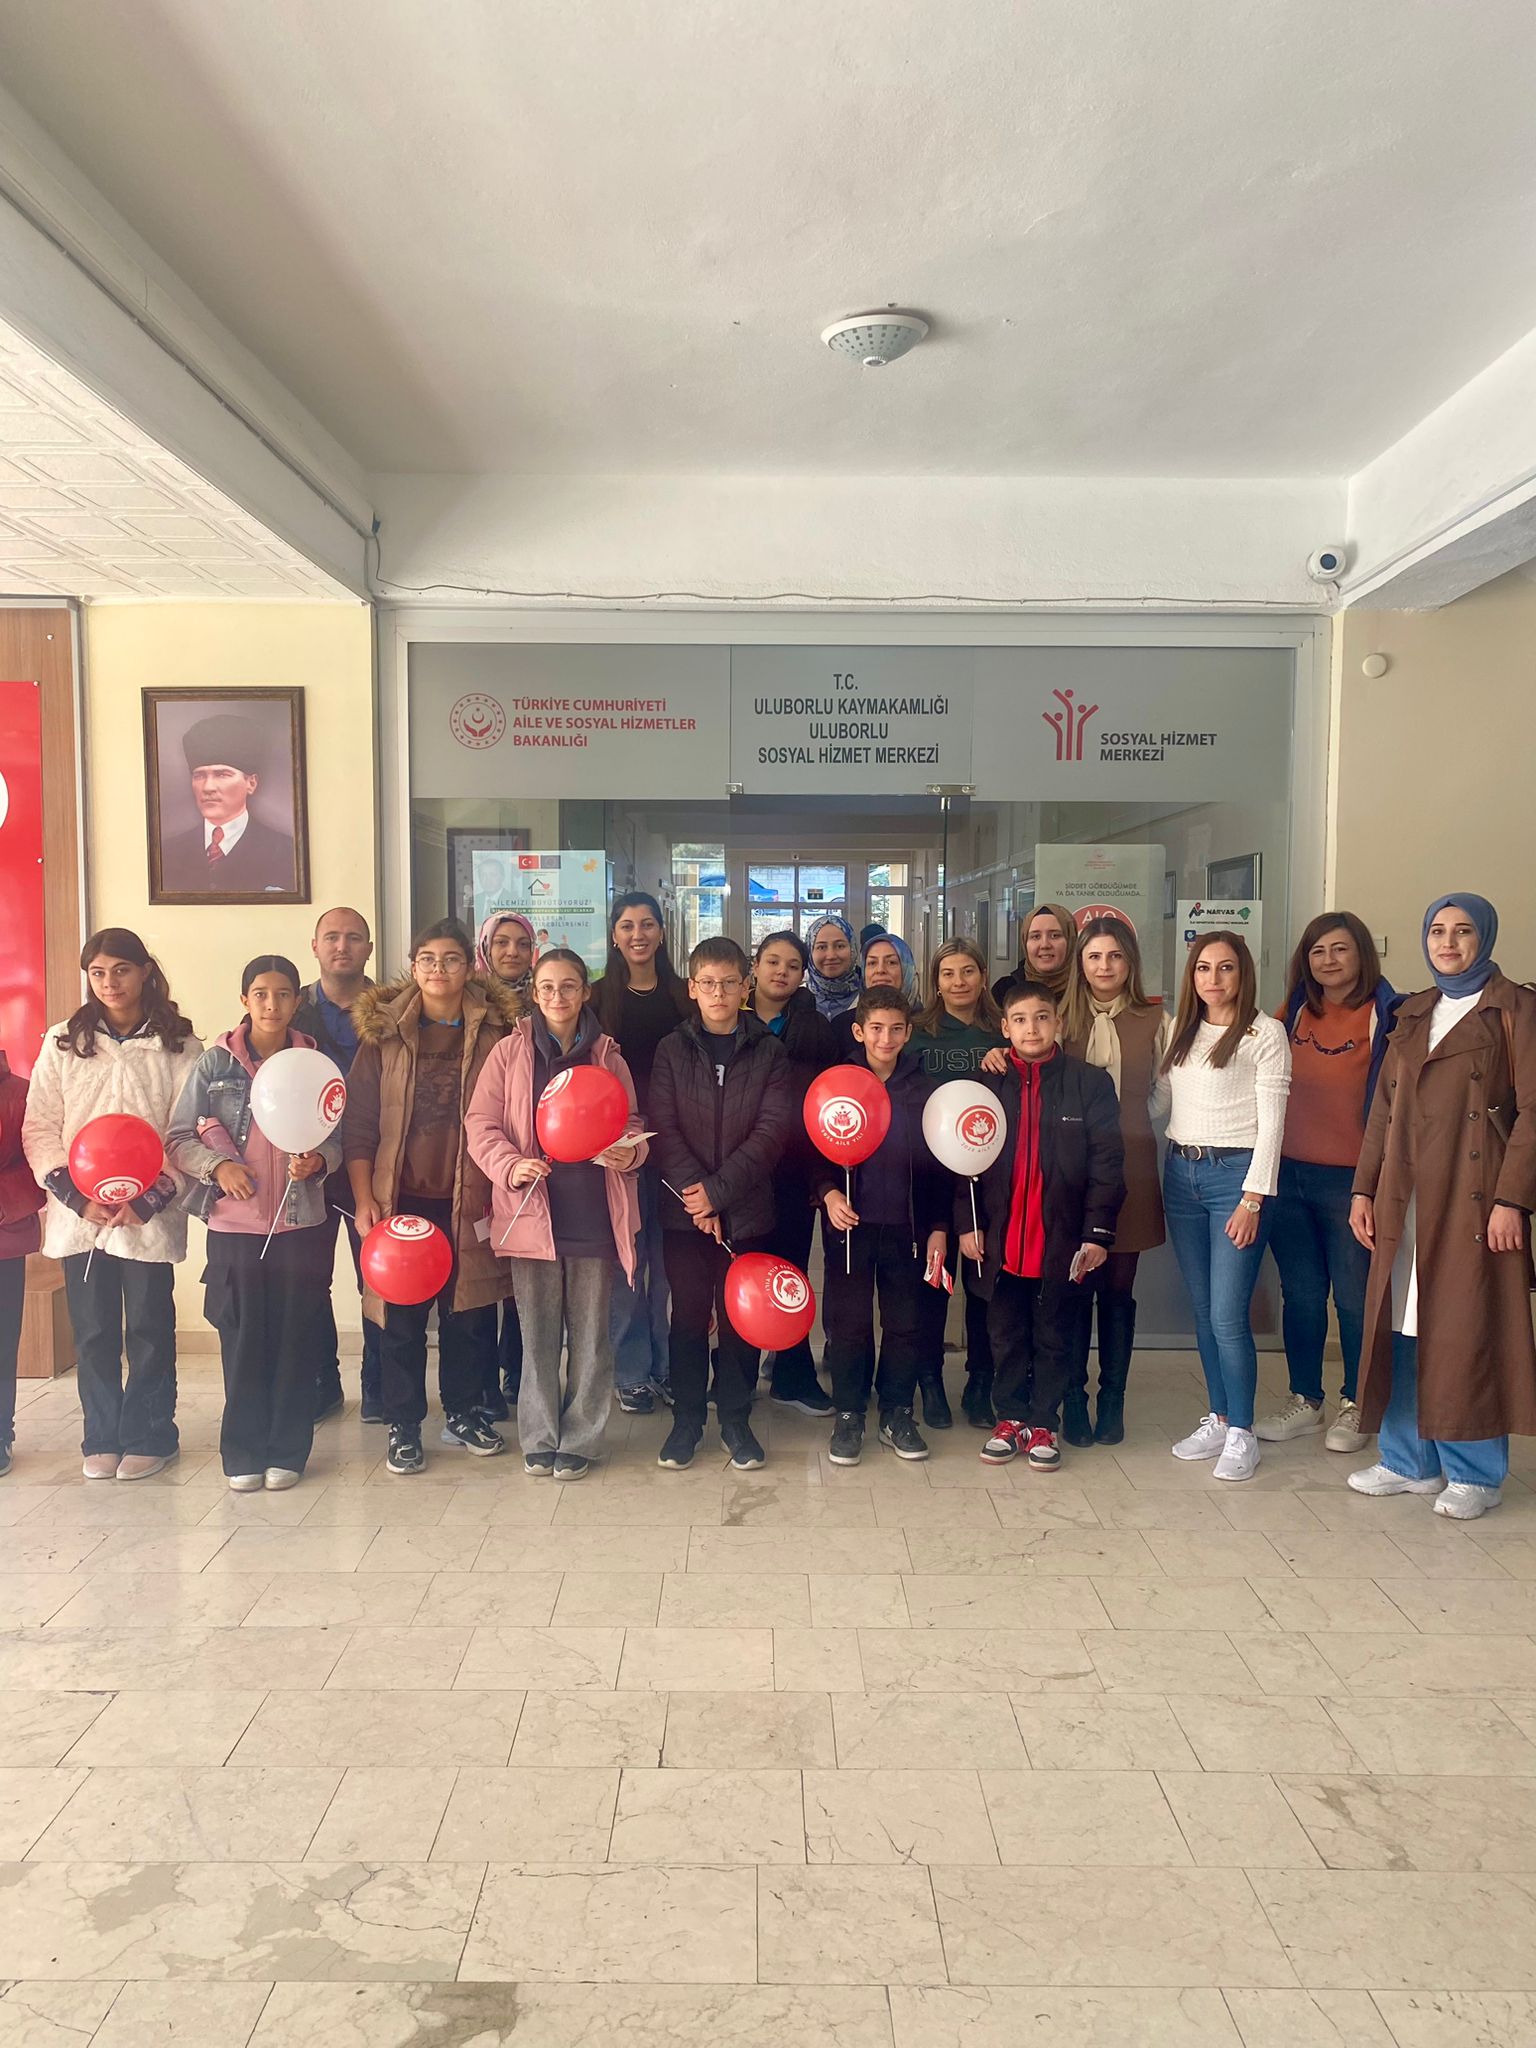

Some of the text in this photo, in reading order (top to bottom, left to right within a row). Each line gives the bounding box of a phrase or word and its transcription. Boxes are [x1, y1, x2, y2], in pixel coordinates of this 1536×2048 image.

[833, 673, 858, 690] T.C.
[512, 696, 666, 712] TÜRKİYE CUMHURİYETİ
[754, 694, 949, 715] ULUBORLU KAYMAKAMLIĞI
[513, 716, 696, 731] AİLE VE SOSYAL HİZMETLER
[809, 722, 888, 739] ULUBORLU
[513, 733, 588, 747] BAKANLIĞI
[1100, 731, 1217, 746] SOSYAL HİZMET
[758, 743, 939, 764] SOSYAL HİZMET MERKEZİ
[1100, 746, 1164, 761] MERKEZİ
